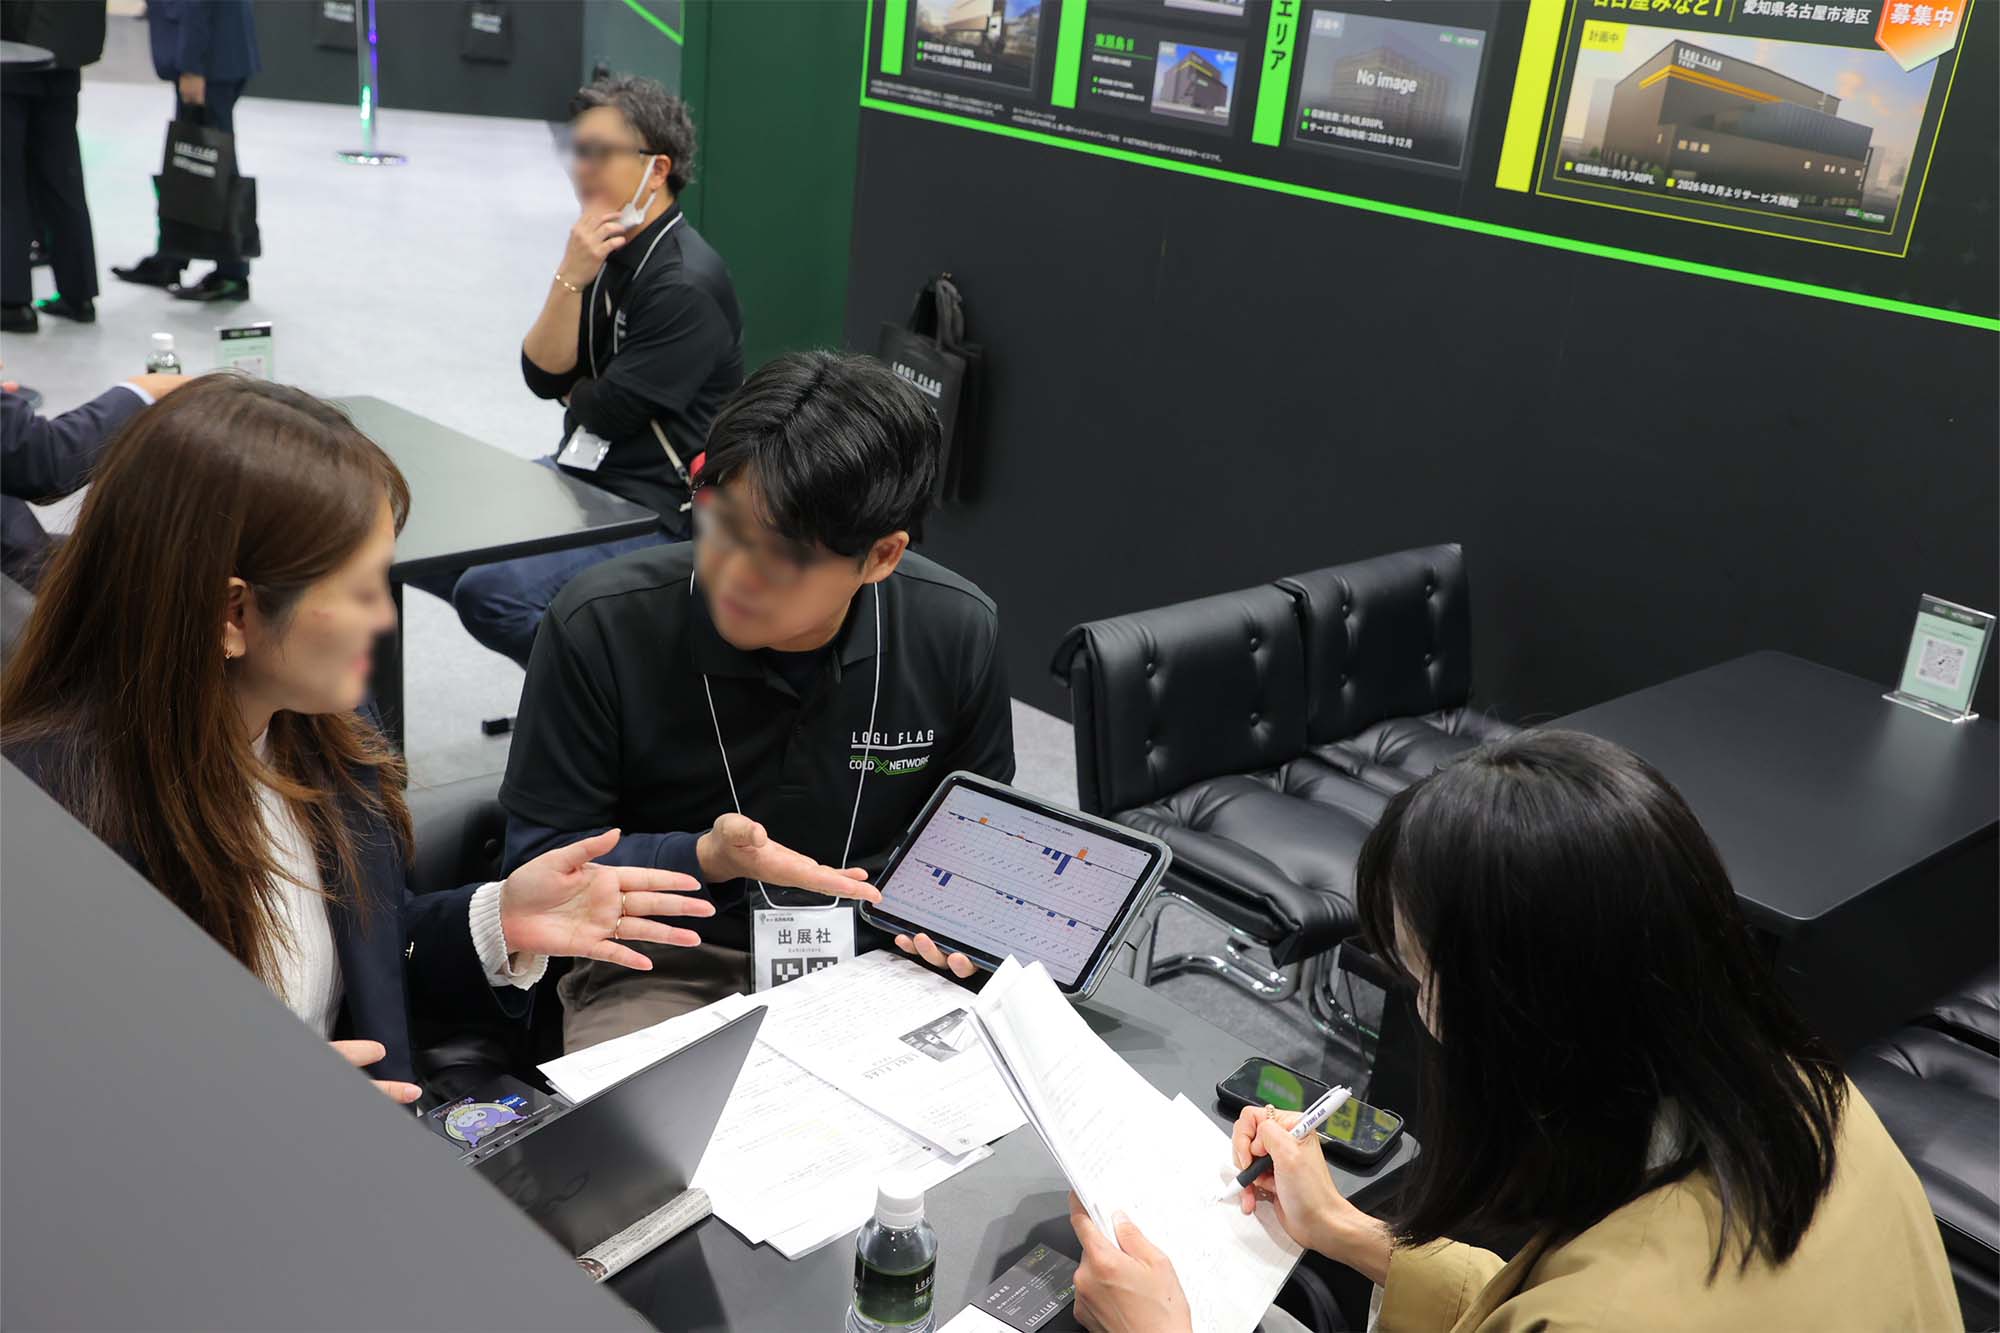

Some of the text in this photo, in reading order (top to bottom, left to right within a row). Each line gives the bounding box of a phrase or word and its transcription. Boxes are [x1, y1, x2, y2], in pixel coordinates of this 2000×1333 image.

[1742, 0, 1872, 25] 愛知県名古屋市港区
[1890, 3, 1955, 28] 募集中
[1356, 69, 1418, 95] No image
[852, 729, 934, 745] LOGI FLAG
[778, 927, 832, 945] 出展社
